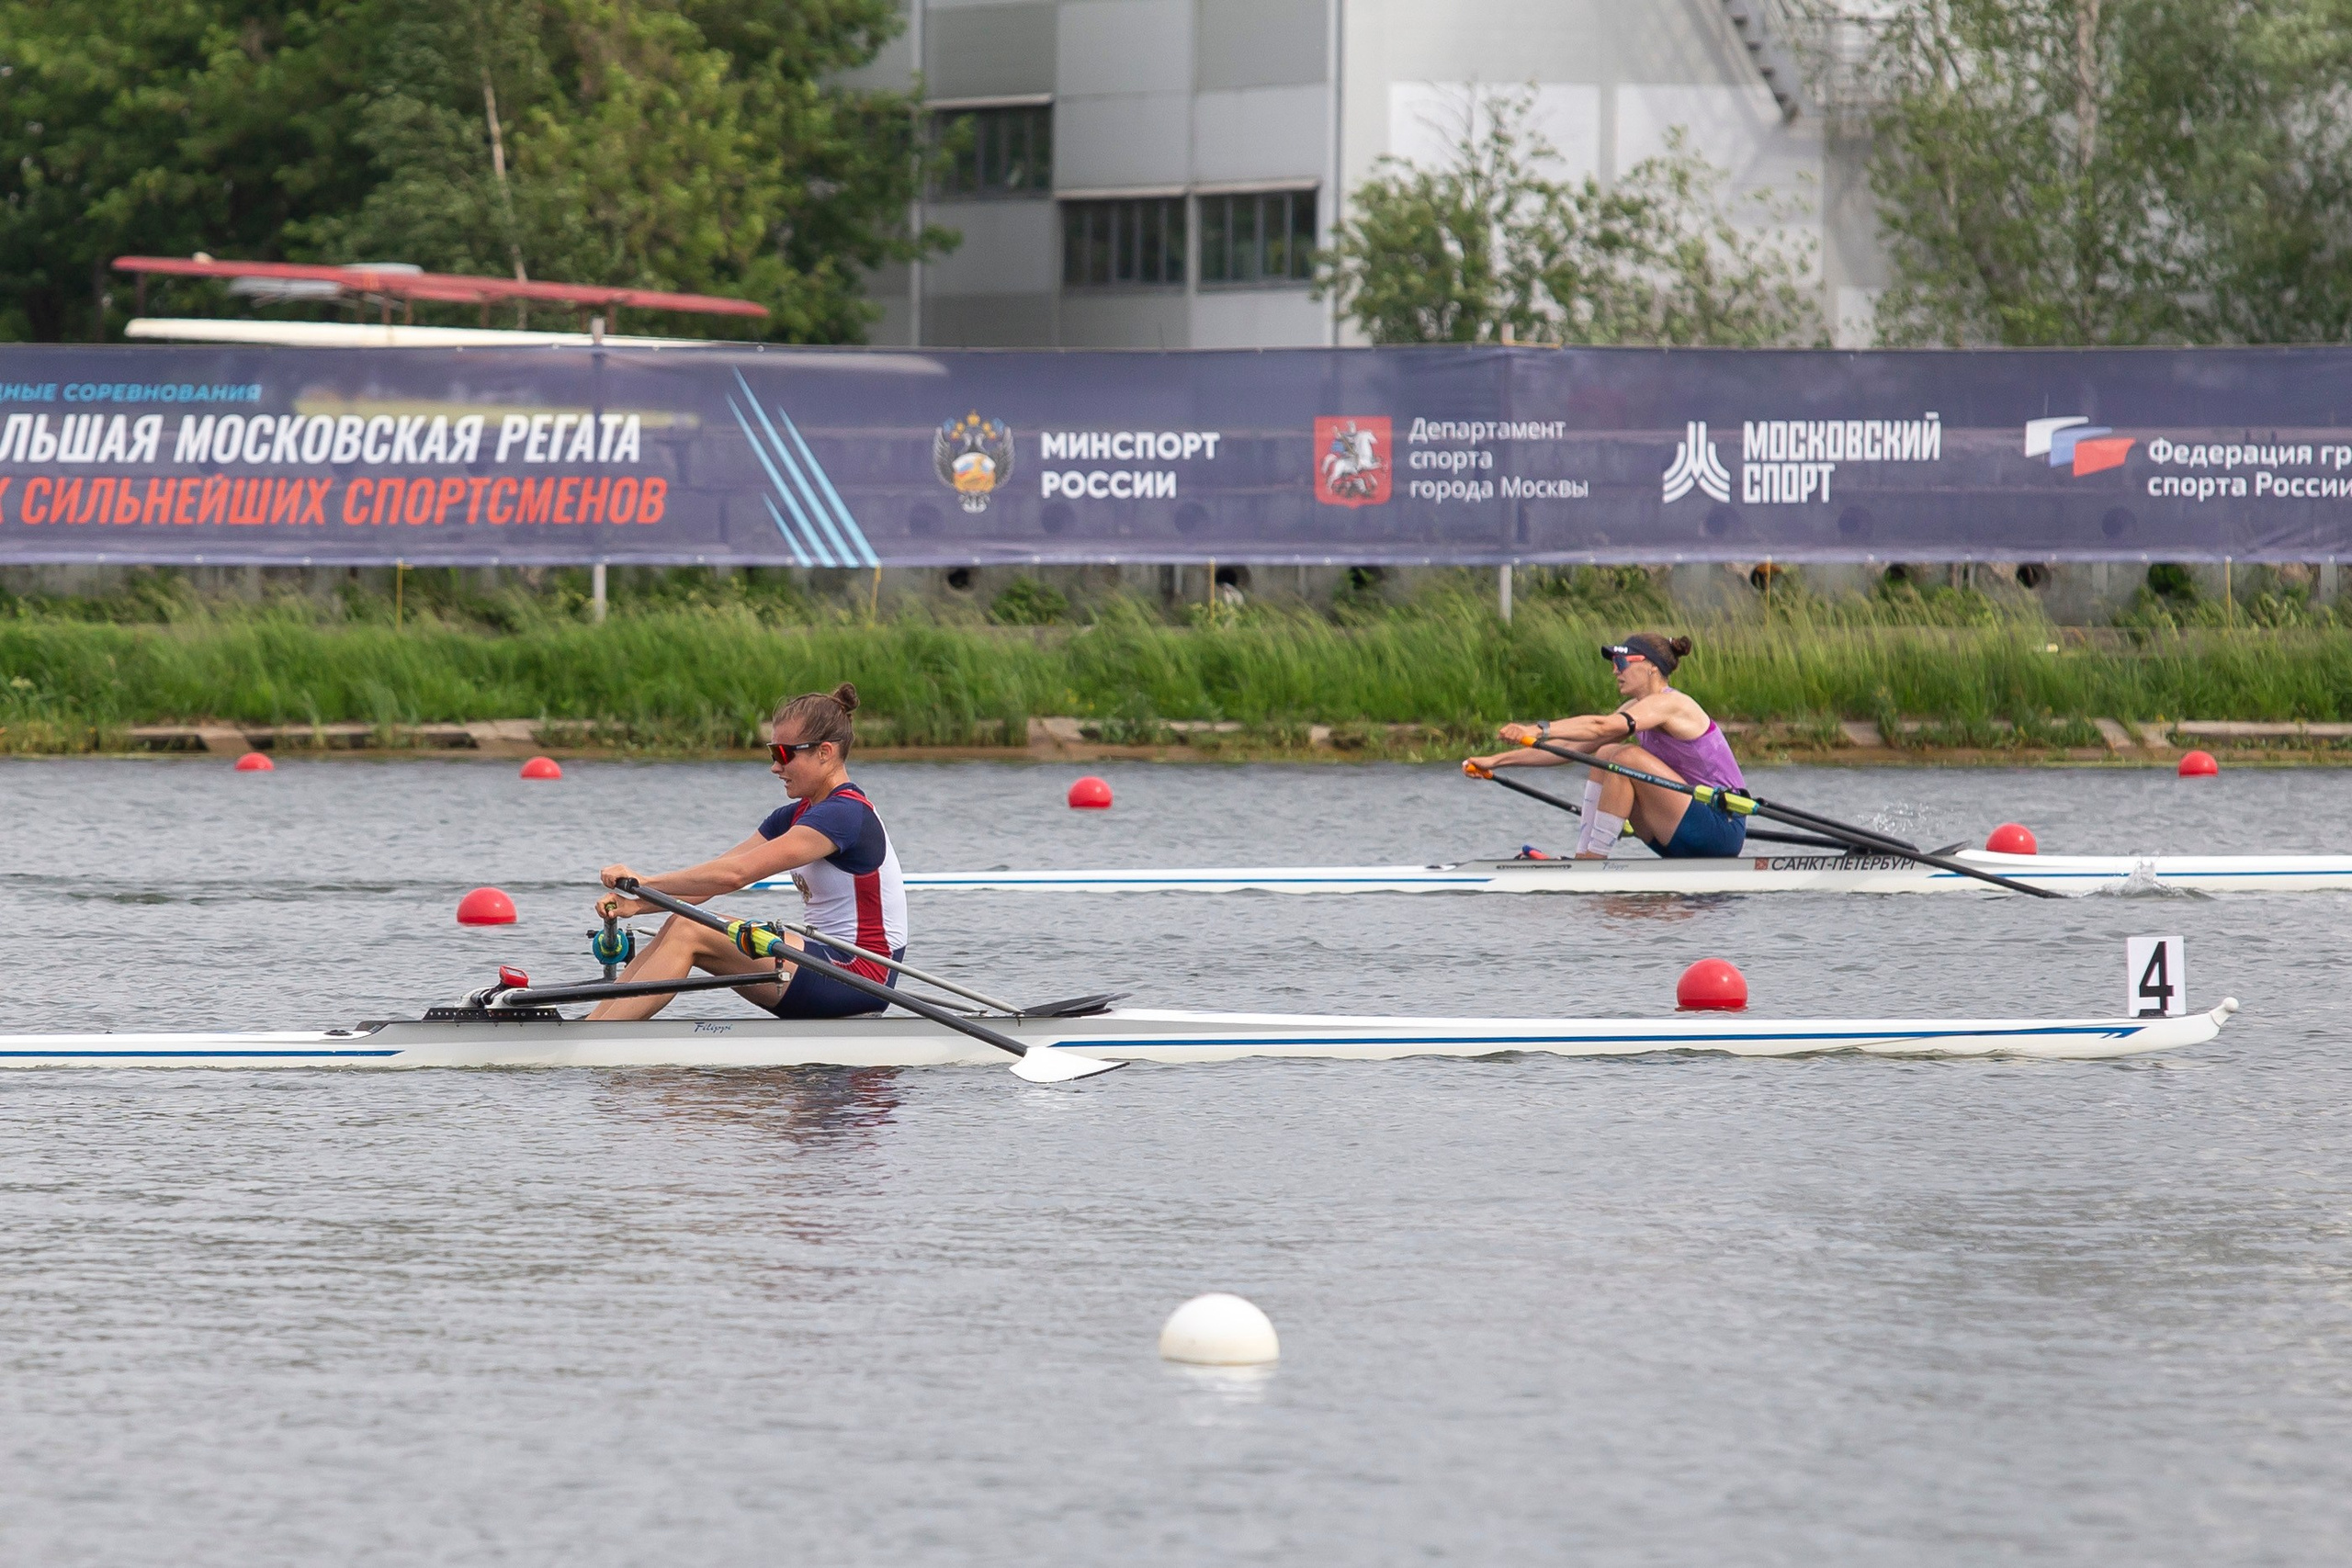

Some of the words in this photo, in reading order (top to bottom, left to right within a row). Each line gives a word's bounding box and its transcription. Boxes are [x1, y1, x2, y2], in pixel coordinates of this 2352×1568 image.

[0, 383, 58, 402] НЫЕ
[62, 383, 263, 402] СОРЕВНОВАНИЯ
[0, 413, 164, 463] ЛЬШАЯ
[174, 413, 485, 463] МОСКОВСКАЯ
[494, 413, 641, 463] РЕГАТА
[1040, 431, 1220, 460] МИНСПОРТ
[1408, 418, 1566, 445] Департамент
[1743, 411, 1941, 461] МОСКОВСКИЙ
[1408, 450, 1493, 475] спорта
[2148, 437, 2312, 470] Федерация
[2321, 445, 2352, 471] гр
[1040, 470, 1178, 500] РОССИИ
[1409, 479, 1494, 504] города
[1500, 476, 1589, 500] Москвы
[1743, 462, 1836, 503] СПОРТ
[2147, 477, 2247, 502] спорта
[2254, 471, 2352, 498] России
[20, 472, 333, 525] СИЛЬНЕЙШИХ
[342, 476, 668, 525] СПОРТСМЕНОВ
[2139, 941, 2174, 1011] 4
